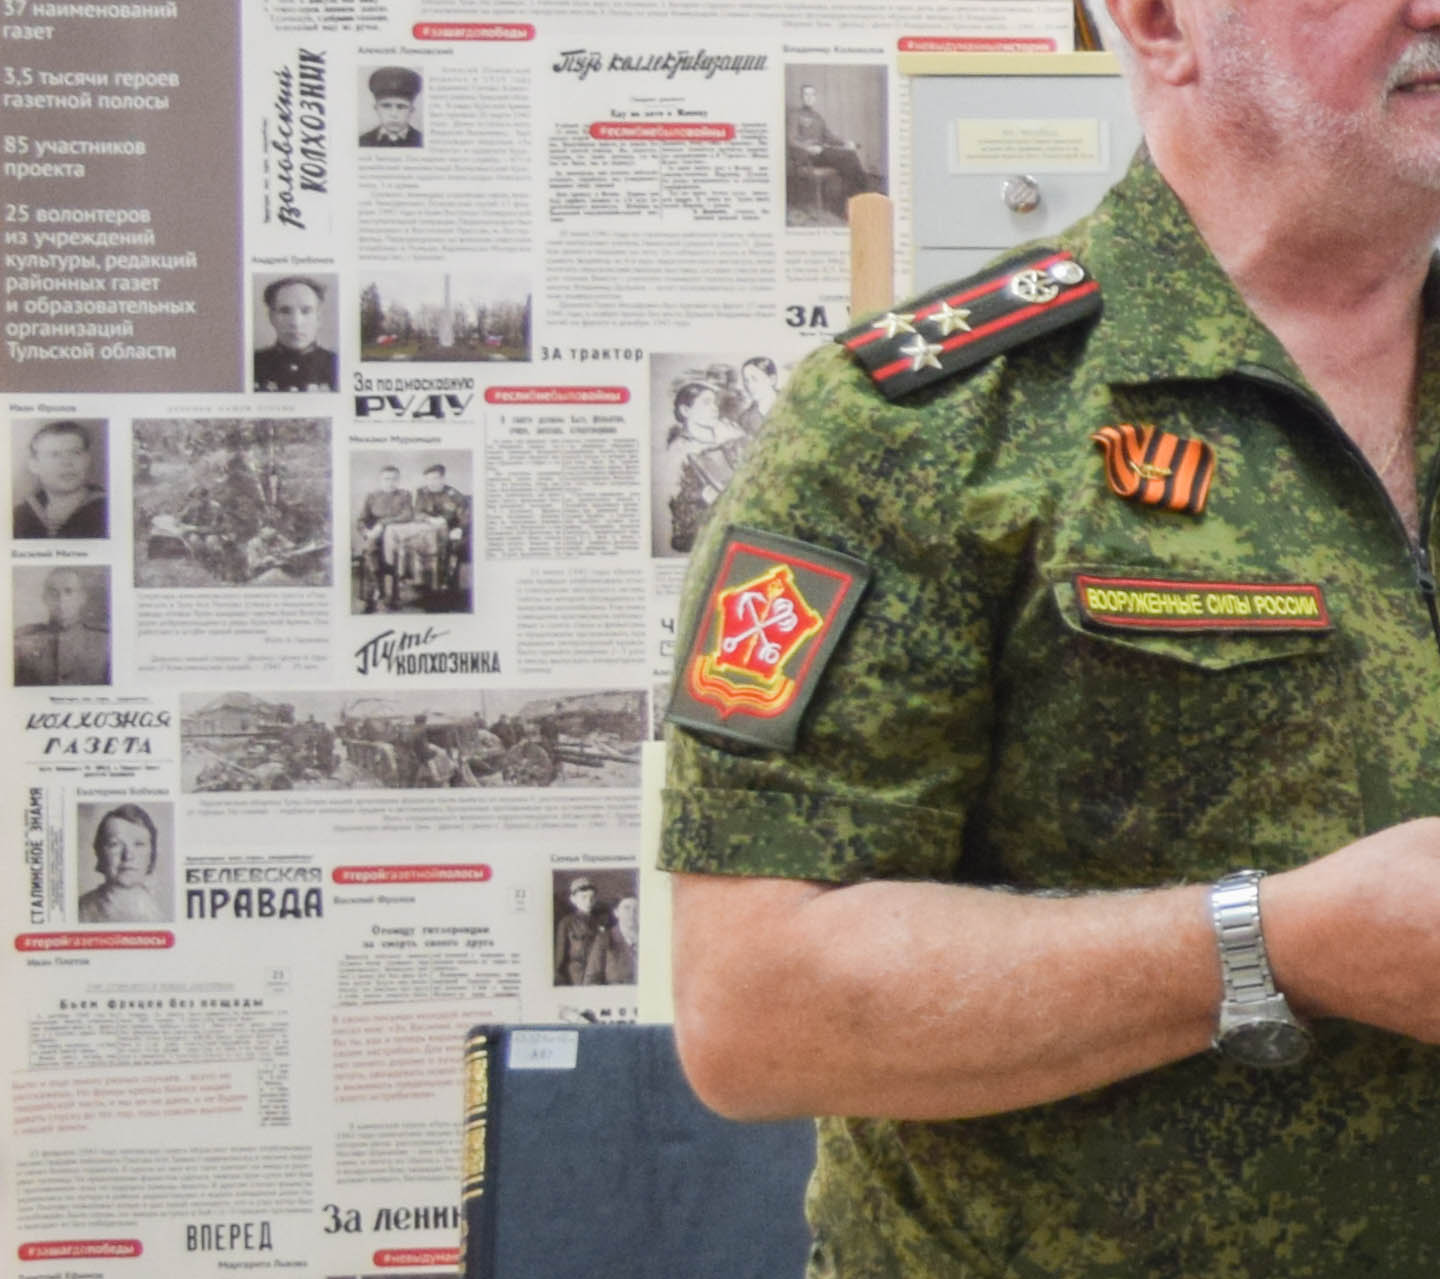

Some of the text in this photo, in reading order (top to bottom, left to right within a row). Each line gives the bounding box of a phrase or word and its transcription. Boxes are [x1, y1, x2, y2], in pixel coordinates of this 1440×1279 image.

[33, 0, 178, 18] наименований
[3, 24, 55, 41] газет
[40, 71, 109, 89] тысячи
[115, 72, 181, 90] героев
[3, 91, 170, 110] газетной полосы
[4, 136, 147, 158] 85 участников
[4, 162, 86, 180] проекта
[5, 204, 151, 226] 25 волонтеров
[5, 229, 155, 251] из учреждений
[5, 252, 198, 273] культуры, редакций
[5, 275, 161, 295] районных газет
[25, 296, 196, 317] образовательных
[5, 320, 134, 340] организаций
[6, 342, 176, 362] Тульской области
[570, 347, 644, 363] трактор
[1086, 587, 1320, 616] ВООРУЖЕННЫЕ СИЛЫ РОССИИ
[42, 736, 154, 756] ГАЗЕТА
[185, 887, 324, 920] ПРАВДА
[322, 1203, 363, 1234] За
[185, 1222, 273, 1252] ВПЕРЕД
